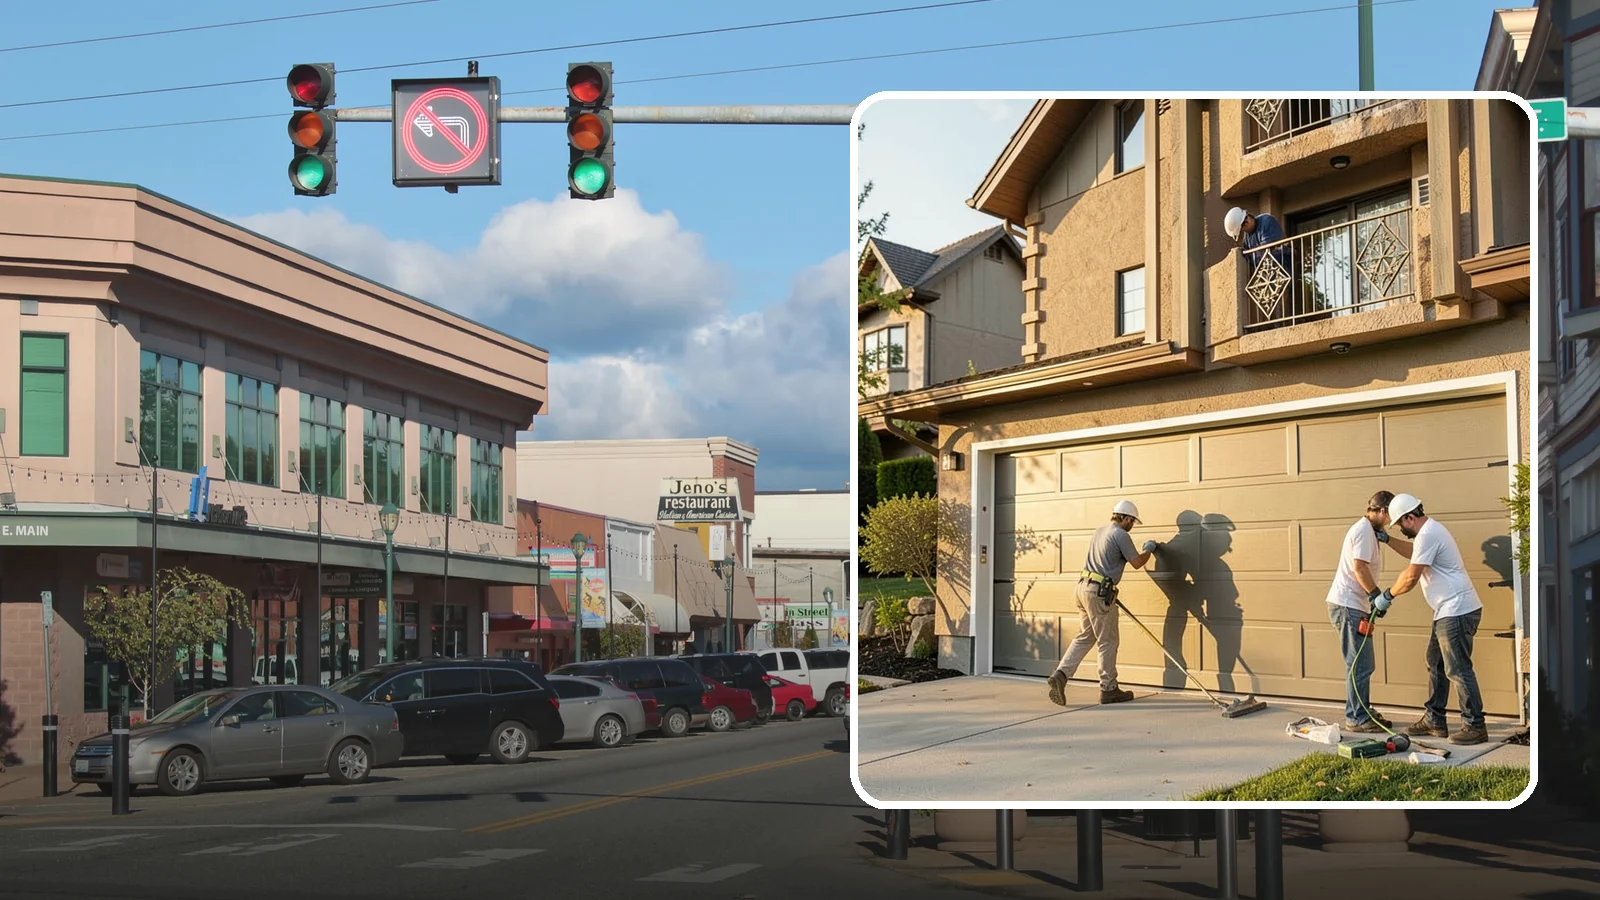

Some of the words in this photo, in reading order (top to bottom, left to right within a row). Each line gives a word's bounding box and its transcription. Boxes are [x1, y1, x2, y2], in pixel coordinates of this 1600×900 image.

[670, 480, 727, 495] Jeno's
[665, 496, 731, 509] restaurant
[658, 510, 681, 519] Italian
[686, 509, 714, 519] American
[715, 509, 737, 519] Cuisine
[2, 525, 13, 536] E.
[15, 525, 49, 536] MAIN
[797, 607, 828, 616] Street
